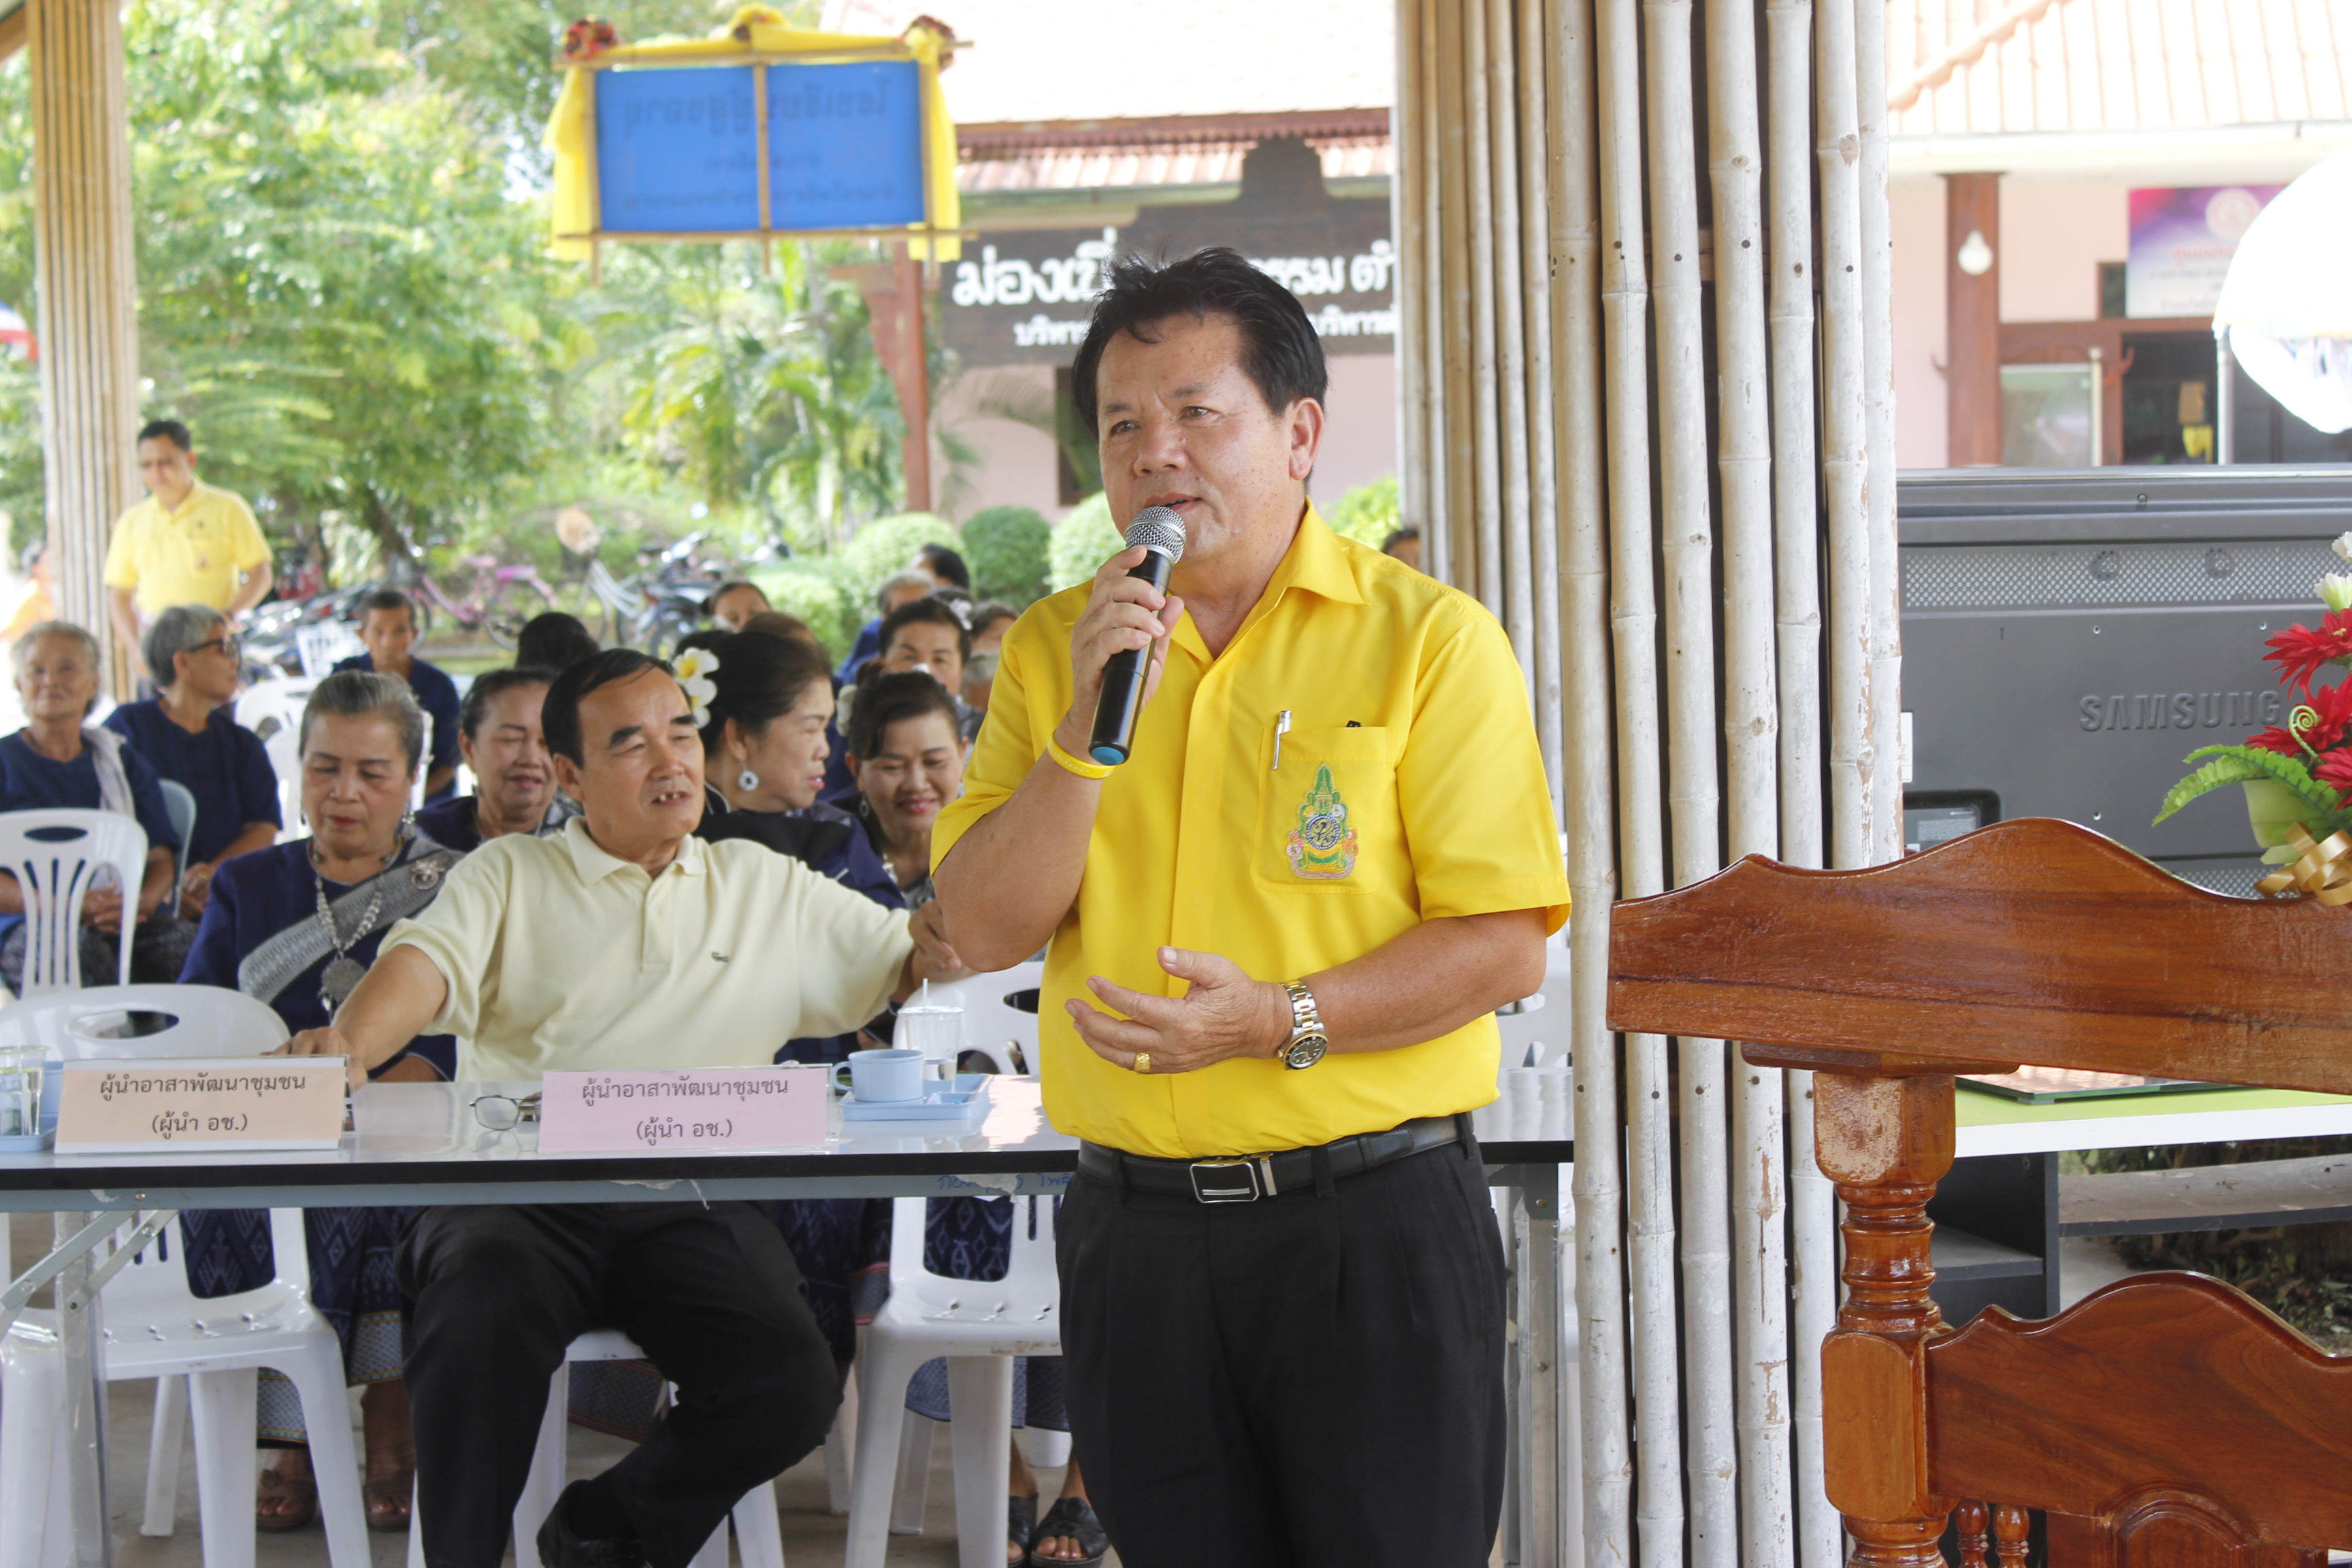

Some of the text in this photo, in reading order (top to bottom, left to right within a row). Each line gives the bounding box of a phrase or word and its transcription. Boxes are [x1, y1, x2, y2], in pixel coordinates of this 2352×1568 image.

[2079, 691, 2280, 732] SAMSUNG
[100, 1073, 306, 1101] ผู้นำอาสาพัฒนาชุมชน
[583, 1076, 788, 1107] ผู้นำอาสาพัฒนาชุมชน
[152, 1111, 248, 1140] (ผู้นำ อช.)
[636, 1117, 732, 1146] (ผู้นำ อช.)
